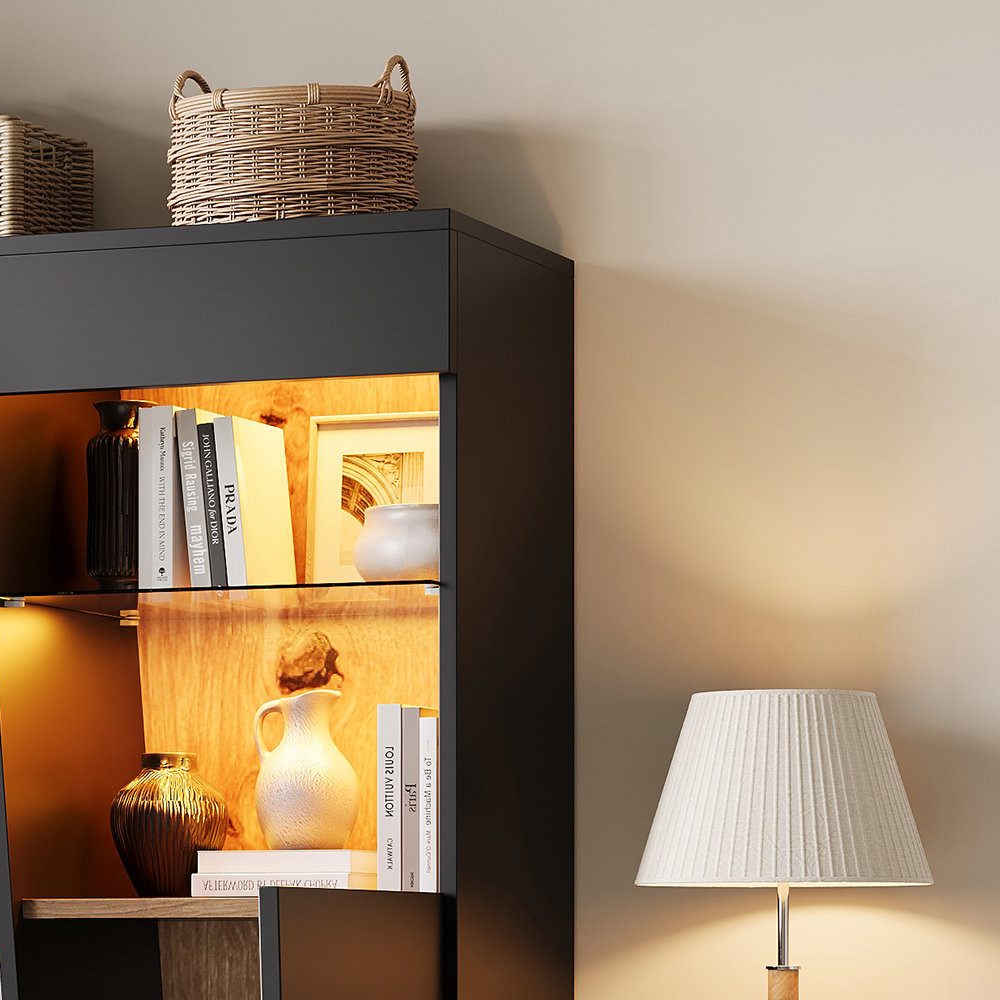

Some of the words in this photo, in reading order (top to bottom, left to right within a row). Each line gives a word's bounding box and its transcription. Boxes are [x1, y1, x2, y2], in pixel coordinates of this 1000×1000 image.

[181, 440, 195, 470] Sigrid
[202, 433, 212, 459] JOHN
[158, 476, 166, 496] WITH
[185, 473, 200, 512] Rausing
[204, 460, 217, 508] GALLIANO
[158, 497, 166, 511] THE
[207, 508, 217, 520] for
[224, 484, 238, 535] PRADA
[158, 513, 166, 529] END
[210, 521, 220, 545] DIOR
[158, 530, 166, 539] IN
[158, 540, 166, 562] MIND
[189, 525, 207, 575] mayhem
